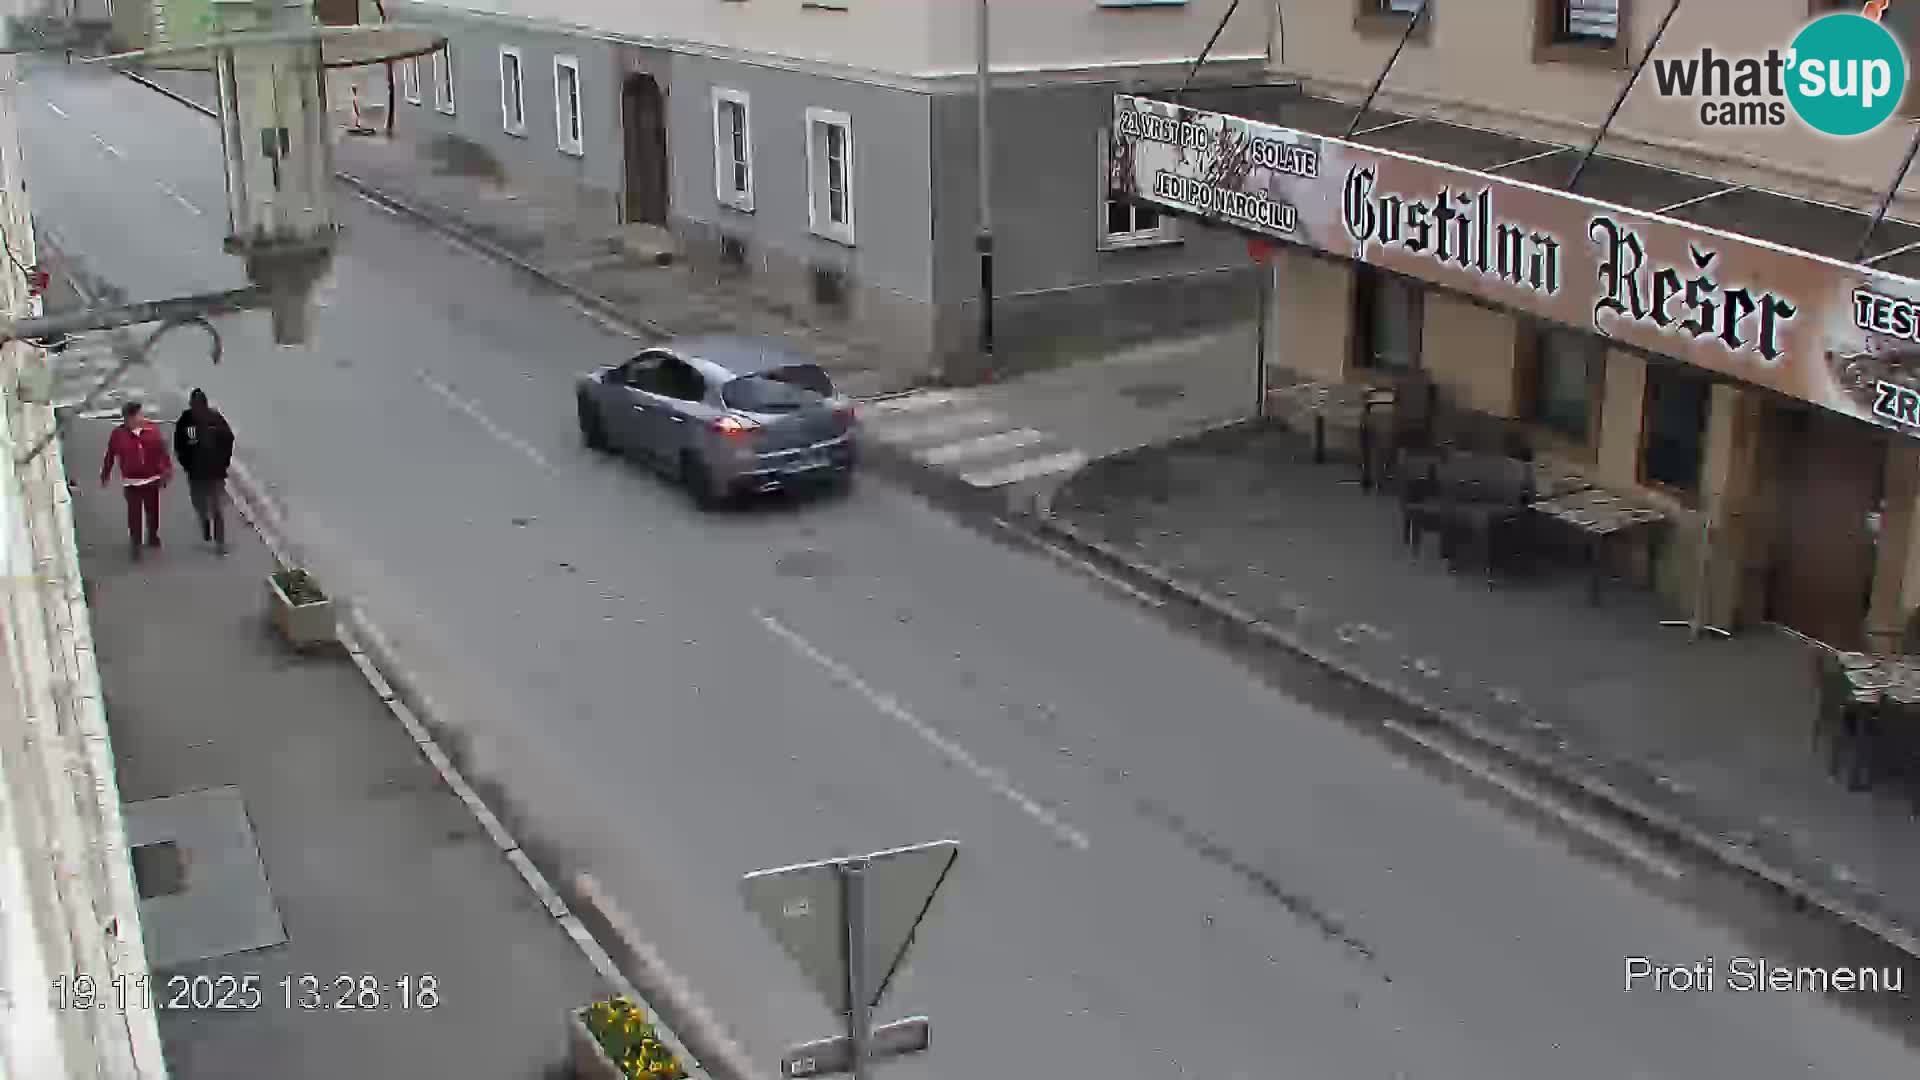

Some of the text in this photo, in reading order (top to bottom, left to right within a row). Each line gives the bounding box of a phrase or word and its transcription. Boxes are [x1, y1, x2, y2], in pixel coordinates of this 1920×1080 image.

[1252, 139, 1318, 177] SOLATE
[1154, 172, 1187, 201] JEDI
[1189, 179, 1212, 206] PO
[1344, 163, 1797, 361] Gostilna Rešer
